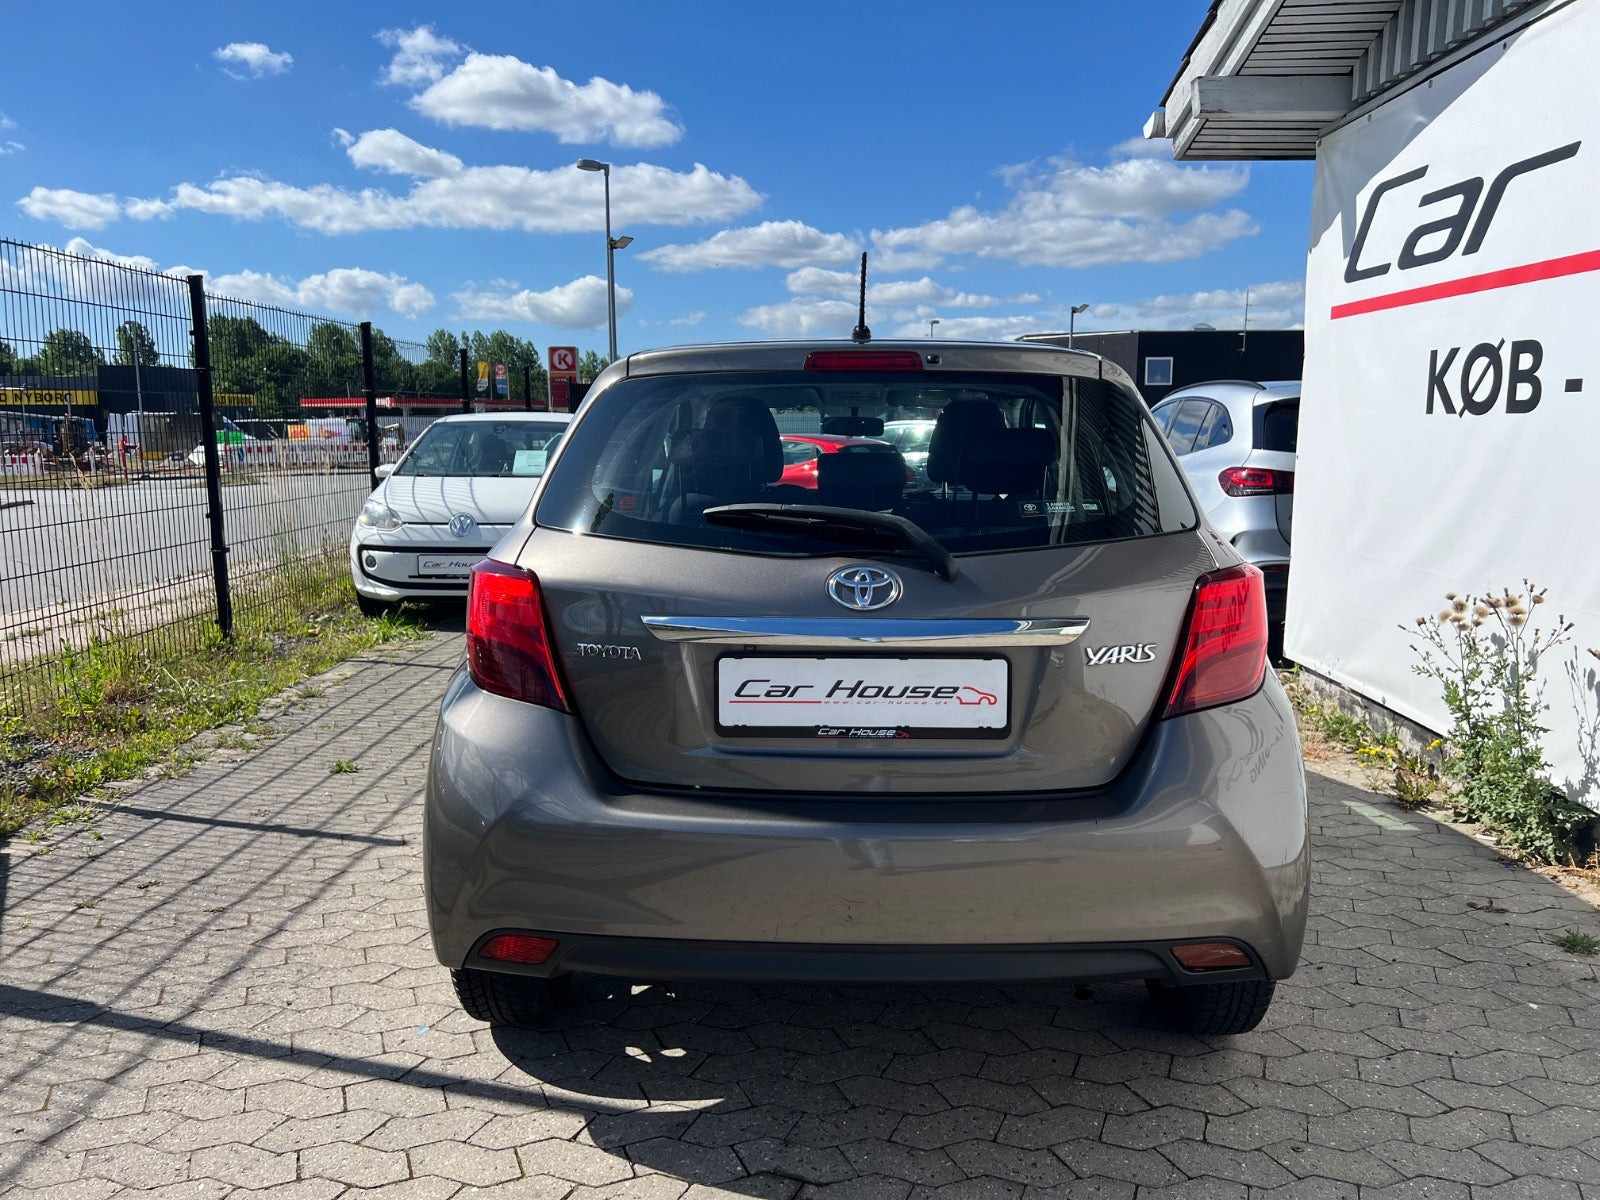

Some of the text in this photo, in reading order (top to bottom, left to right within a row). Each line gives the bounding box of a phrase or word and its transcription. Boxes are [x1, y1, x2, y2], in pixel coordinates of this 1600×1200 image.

[1343, 140, 1582, 283] Car
[558, 353, 572, 368] K
[1426, 337, 1583, 418] KØB -
[423, 560, 446, 568] Car
[576, 642, 642, 661] TOYOTA
[734, 679, 960, 699] Car House
[817, 727, 896, 736] Car House
